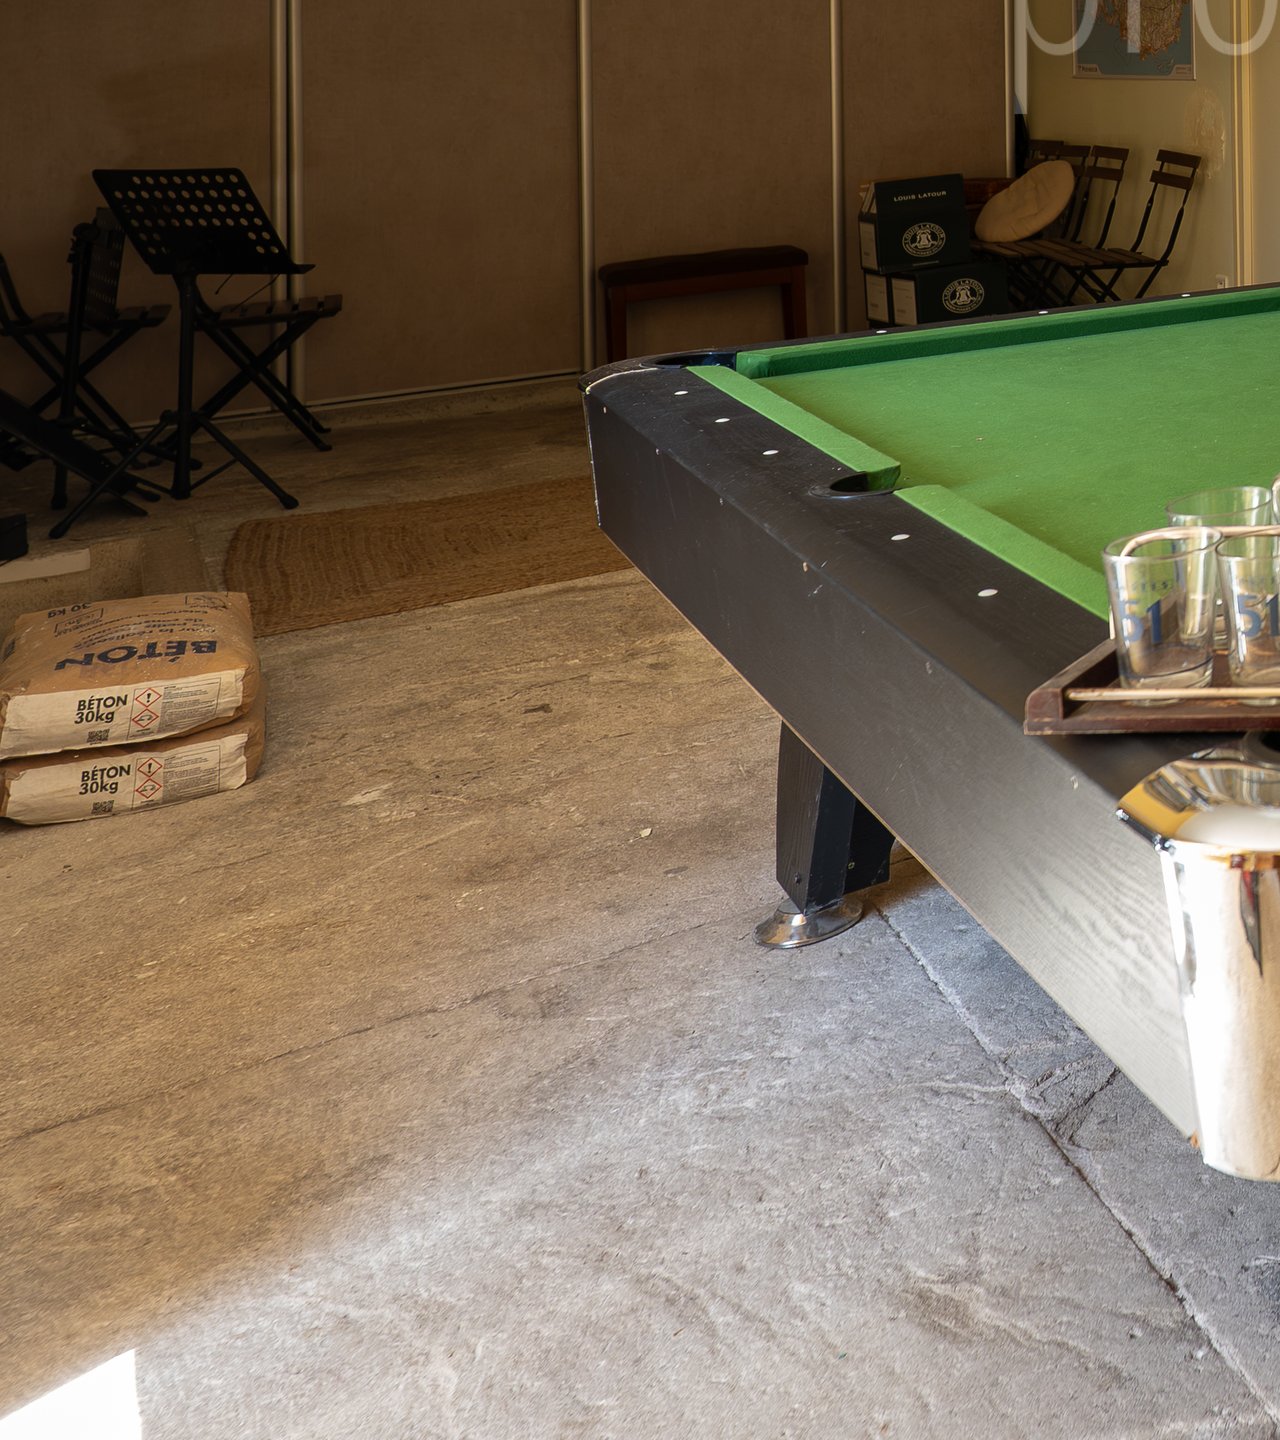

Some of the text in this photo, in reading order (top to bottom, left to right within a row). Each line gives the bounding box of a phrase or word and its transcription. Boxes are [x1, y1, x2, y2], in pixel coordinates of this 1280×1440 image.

[893, 190, 947, 202] LOUIS LATOUR
[1122, 596, 1164, 644] 51
[1237, 591, 1280, 639] 51
[54, 639, 218, 671] BÉTON
[77, 693, 129, 712] BÉTON
[74, 710, 115, 725] 30kg
[80, 763, 131, 783] BÉTON
[79, 781, 119, 795] 30kg
